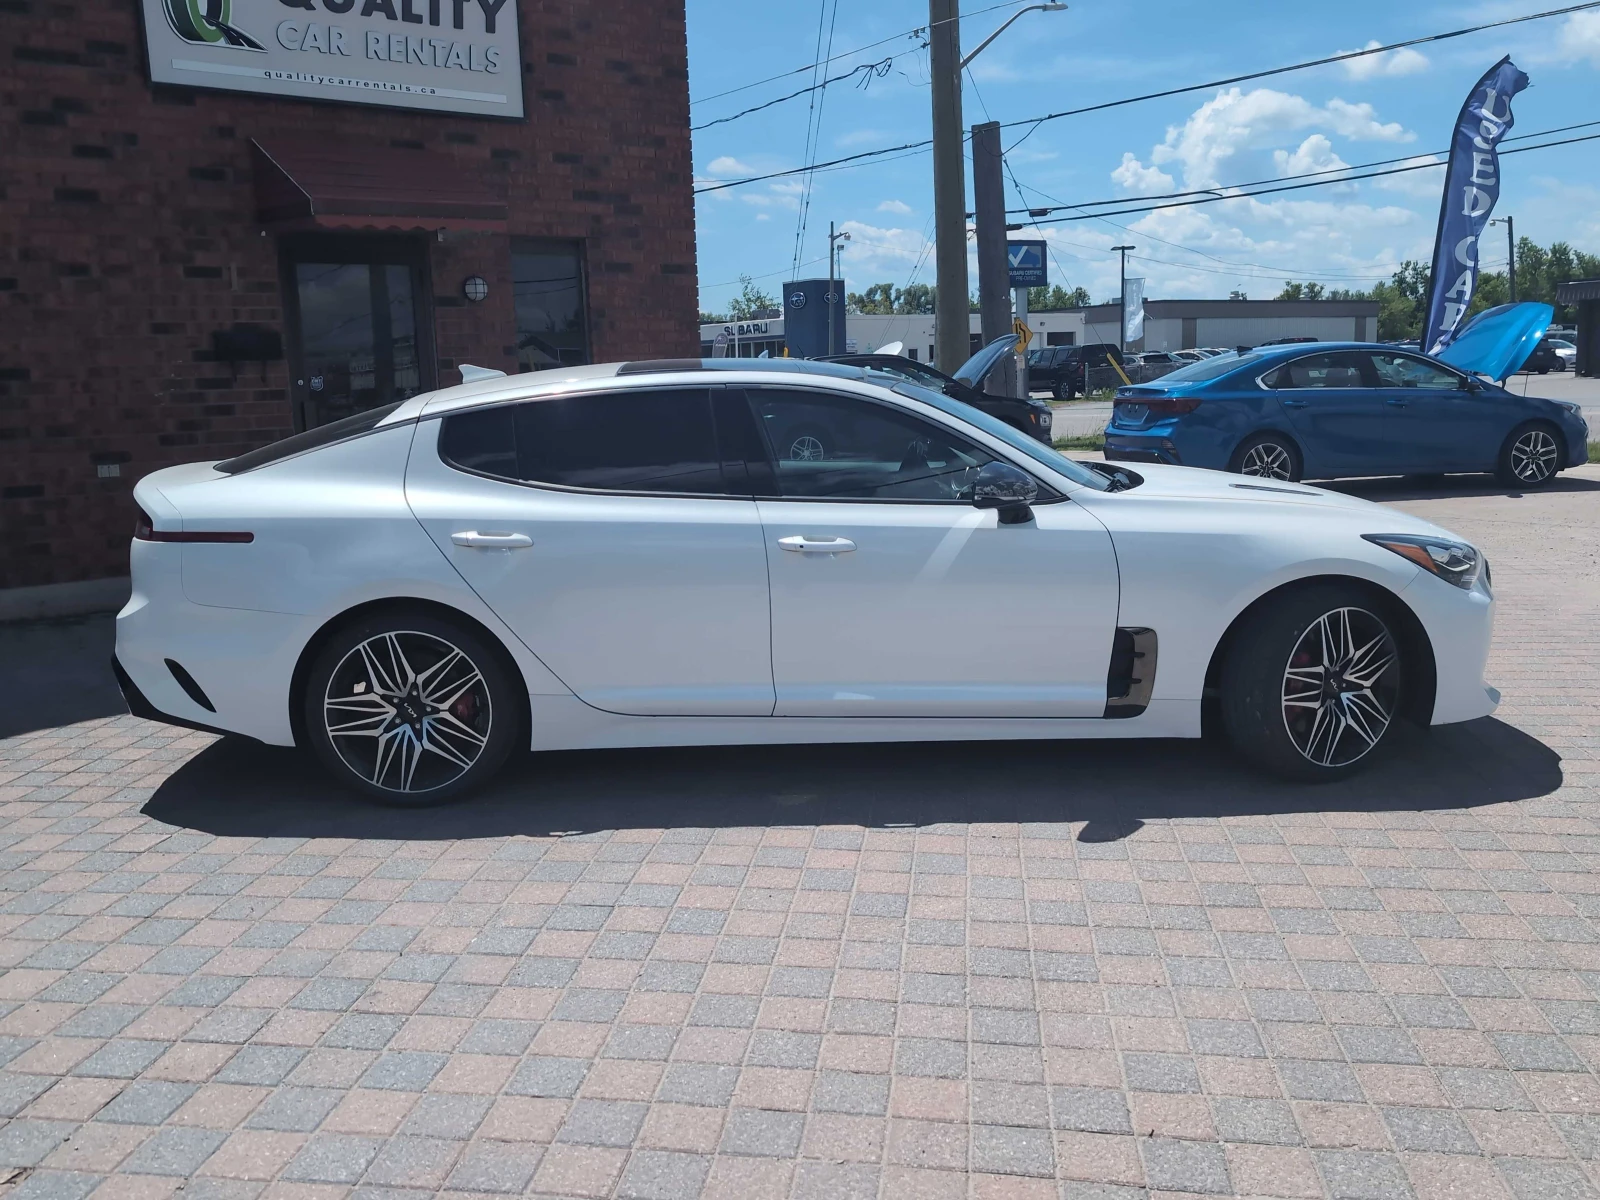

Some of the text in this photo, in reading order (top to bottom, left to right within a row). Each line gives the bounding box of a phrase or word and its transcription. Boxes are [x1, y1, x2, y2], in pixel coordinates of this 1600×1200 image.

[279, 0, 506, 34] ALITY
[276, 20, 502, 74] CAR RENTALS
[264, 70, 436, 95] qualitycarrentals.ca
[1462, 87, 1512, 217] USED
